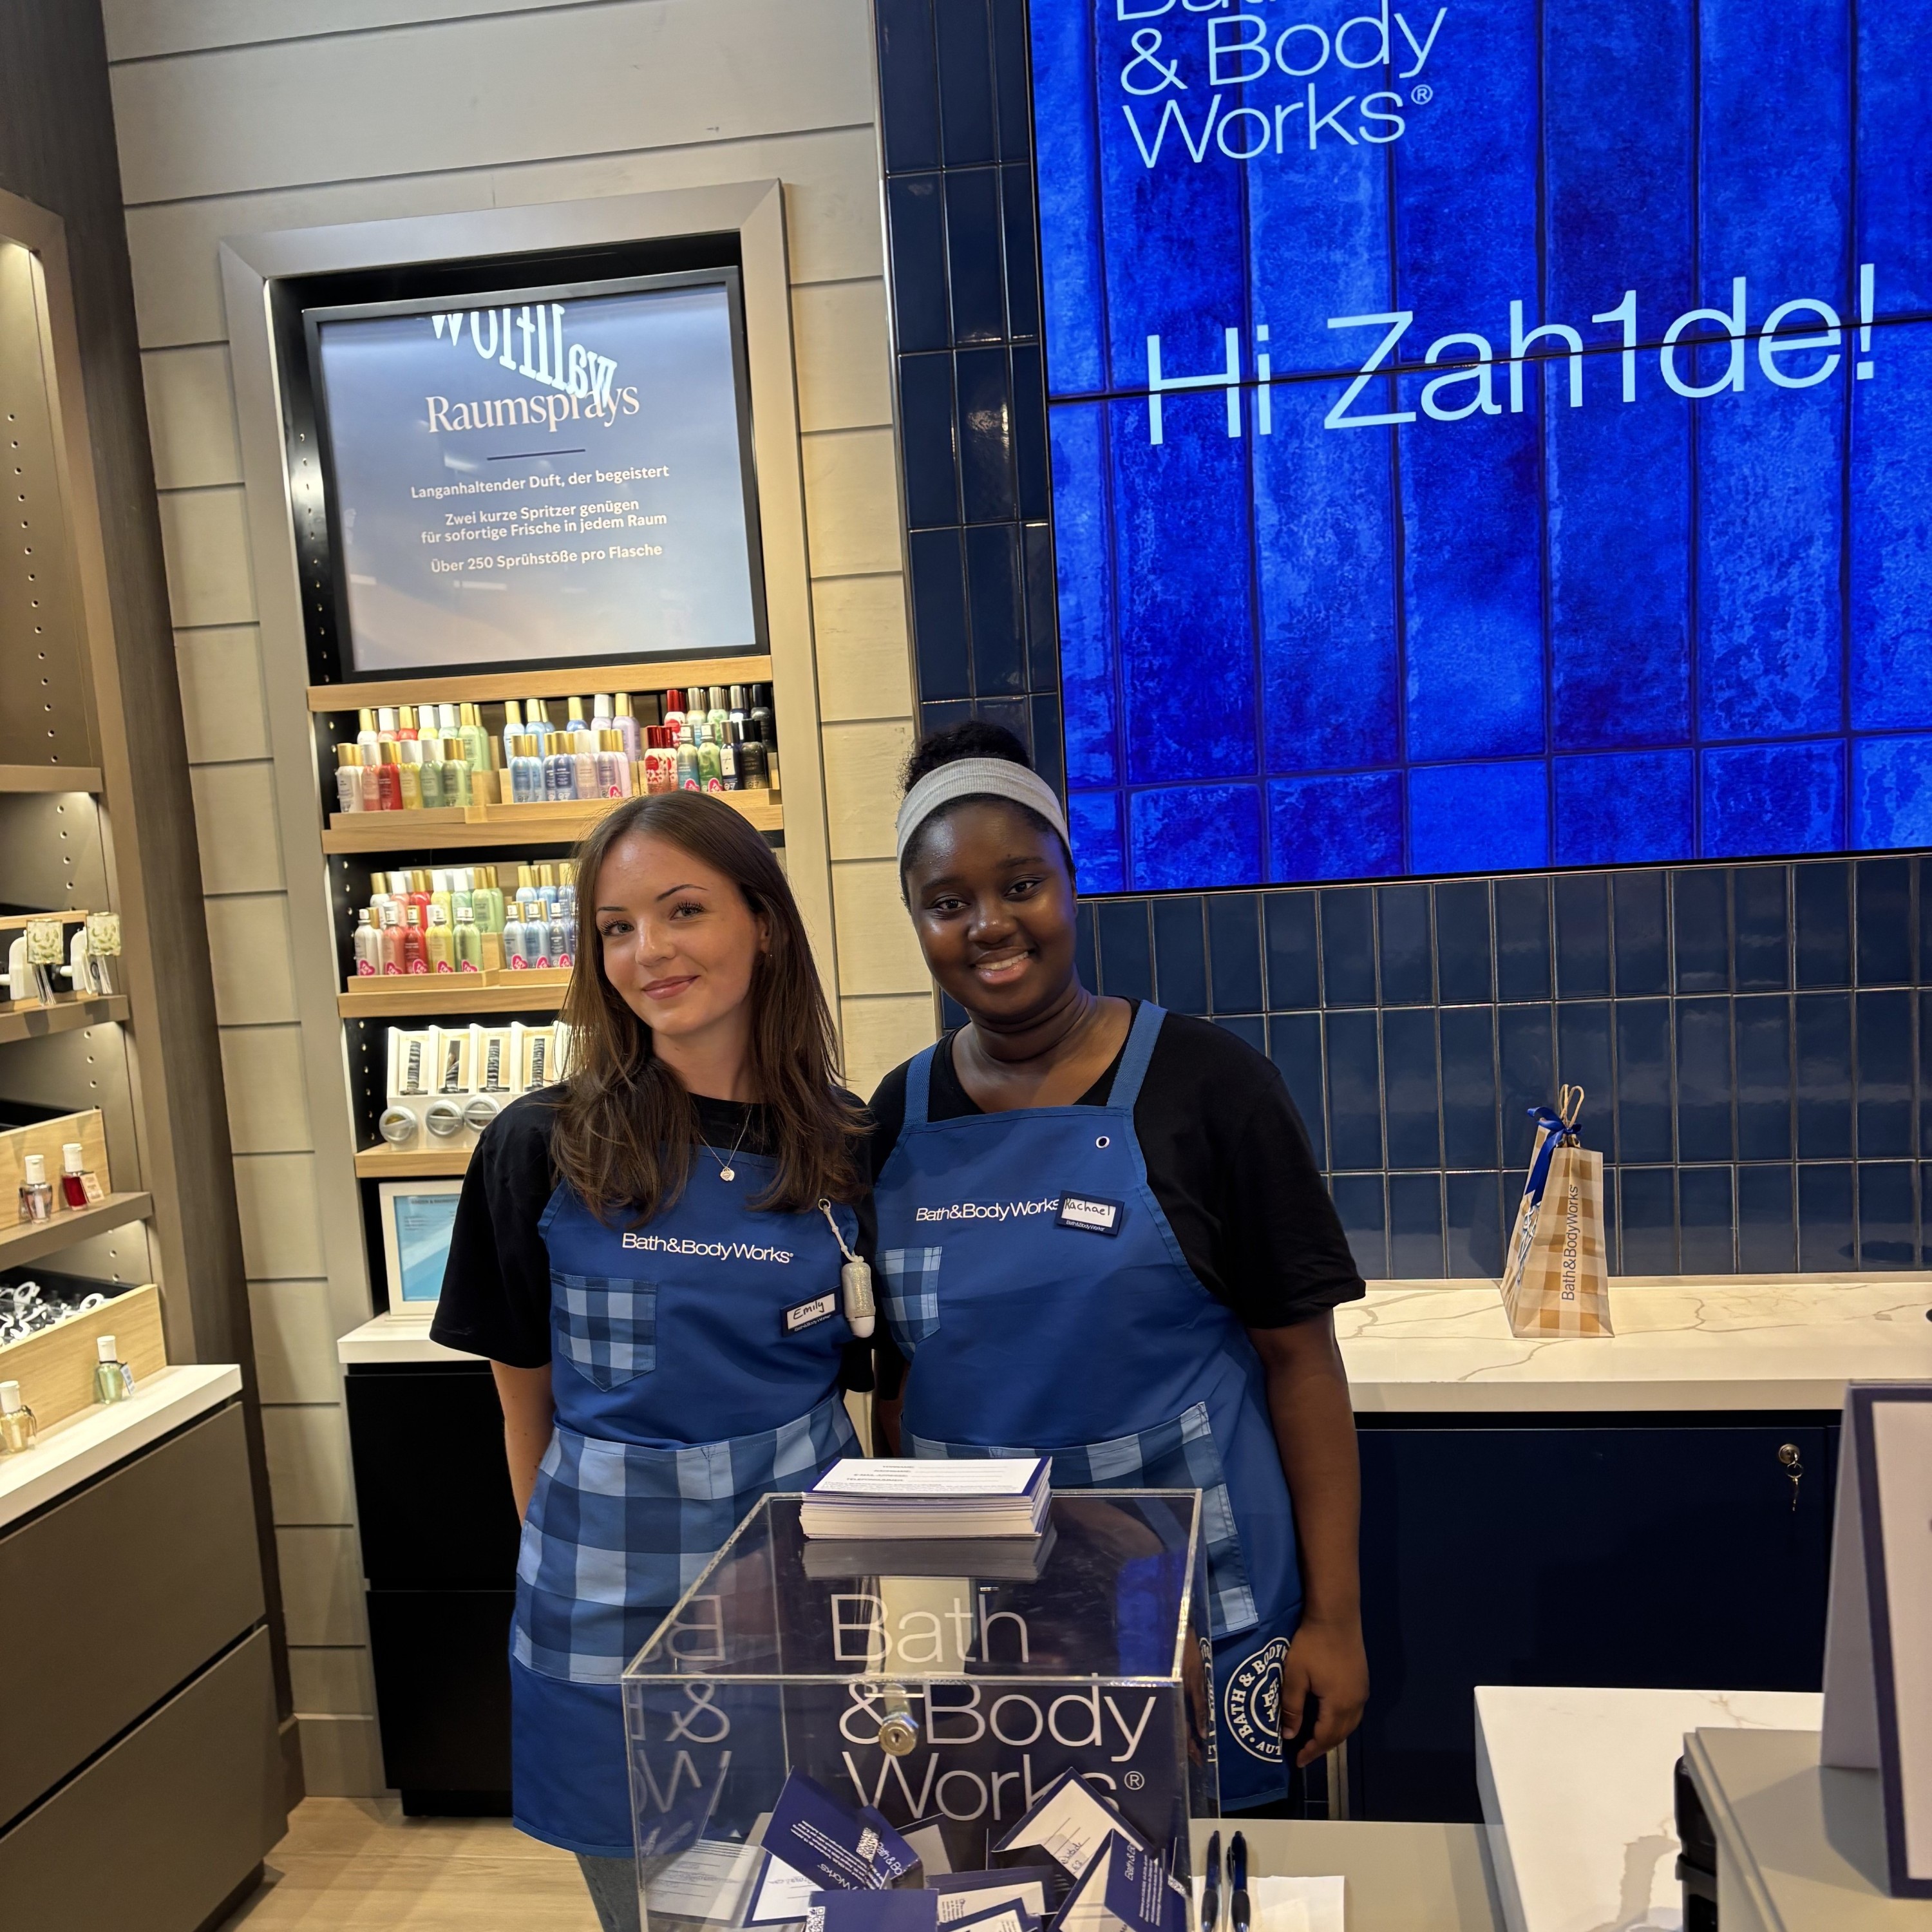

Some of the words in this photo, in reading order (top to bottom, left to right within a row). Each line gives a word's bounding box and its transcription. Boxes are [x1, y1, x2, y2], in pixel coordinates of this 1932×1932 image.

[1121, 27, 1188, 96] &
[1208, 0, 1448, 86] Body
[1146, 323, 1272, 445] Hi
[1323, 263, 1875, 430] Zah1de!
[424, 386, 641, 433] Raumsprays
[411, 478, 526, 499] Langanhaltender
[529, 474, 565, 488] Duft,
[568, 472, 592, 485] der
[595, 466, 670, 484] begeistert
[421, 531, 442, 544] für
[444, 526, 507, 541] sofortige
[510, 522, 561, 536] Frische
[564, 520, 577, 532] in
[580, 517, 624, 533] jedem
[627, 514, 667, 527] Raum
[445, 511, 477, 526] Zwei
[479, 510, 517, 523] kurze
[520, 505, 576, 521] Spritzer
[580, 500, 639, 518] genügen
[431, 558, 464, 573] Über
[467, 556, 494, 570] 250
[497, 550, 578, 569] Sprühstöße
[581, 550, 606, 564] pro
[609, 544, 663, 559] Flasche
[1064, 1197, 1111, 1217] Rachael
[793, 1300, 825, 1320] Emily
[831, 1594, 1030, 1663] Bath
[1251, 1644, 1282, 1675] BODY
[1238, 1672, 1256, 1687] &
[923, 1671, 1157, 1763] Body
[1231, 1689, 1254, 1739] BATH
